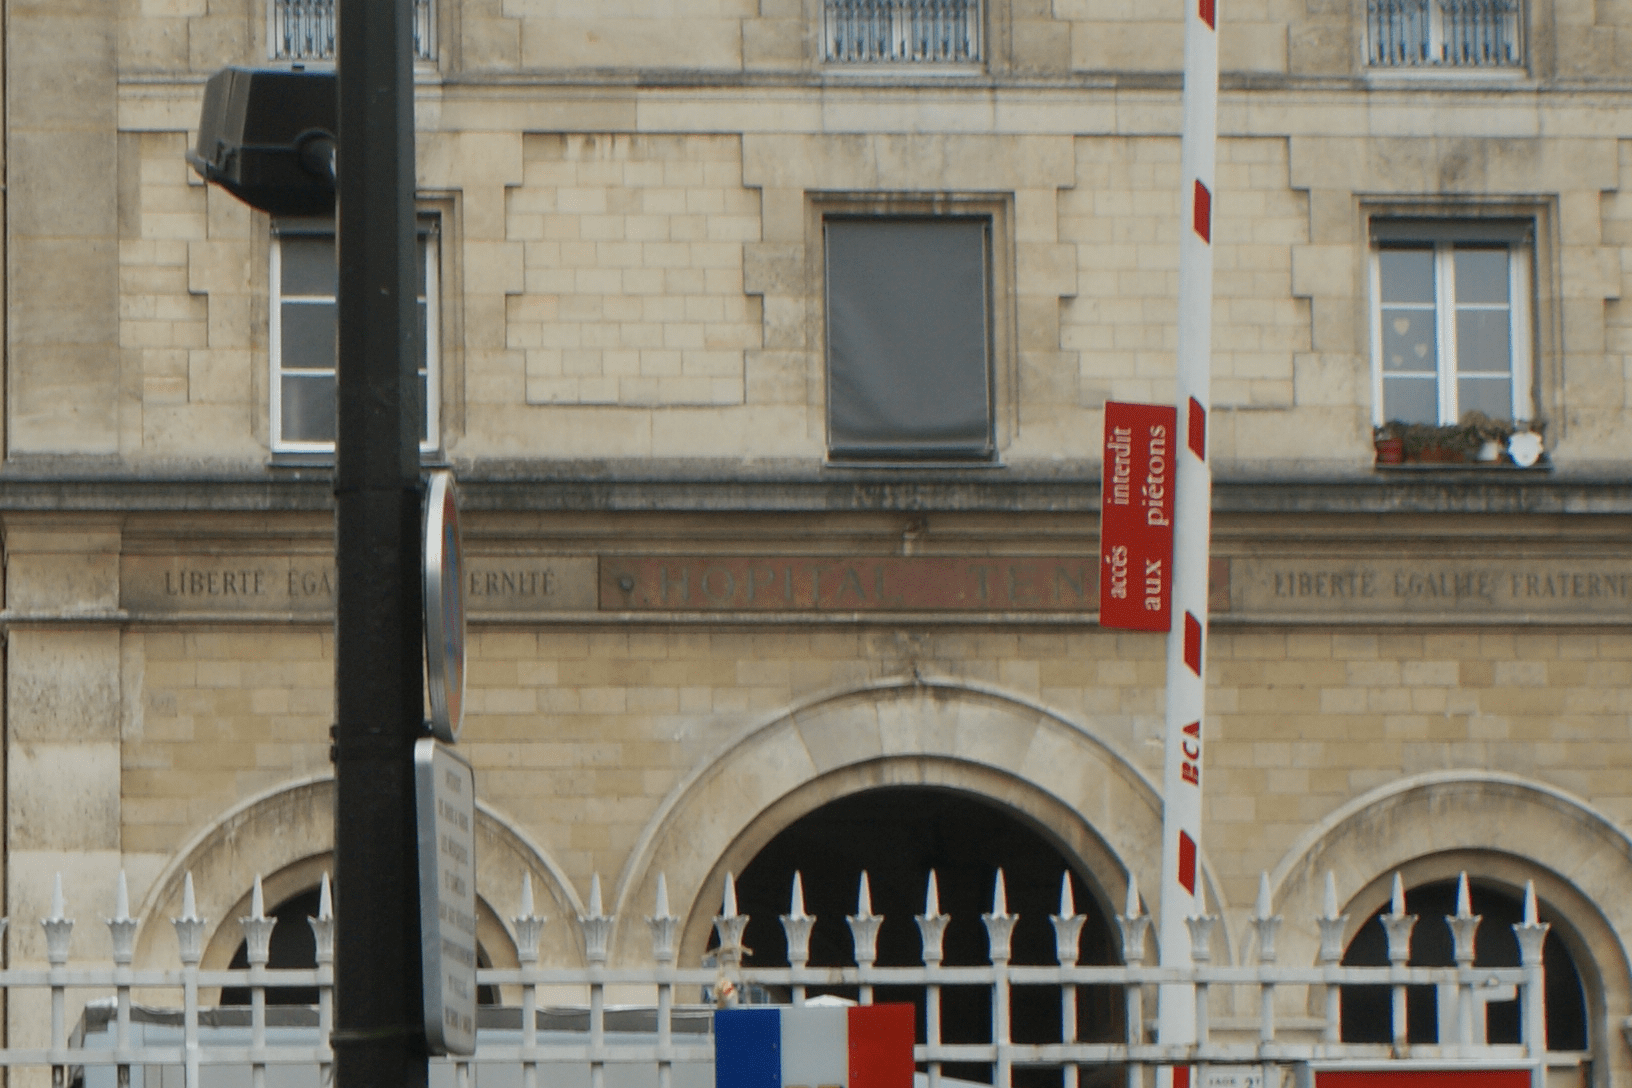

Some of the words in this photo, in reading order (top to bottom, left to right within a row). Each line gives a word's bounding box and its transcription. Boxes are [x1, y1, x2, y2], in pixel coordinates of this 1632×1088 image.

[1106, 425, 1131, 505] interdit
[1141, 424, 1170, 527] piétons
[1144, 557, 1162, 612] aux
